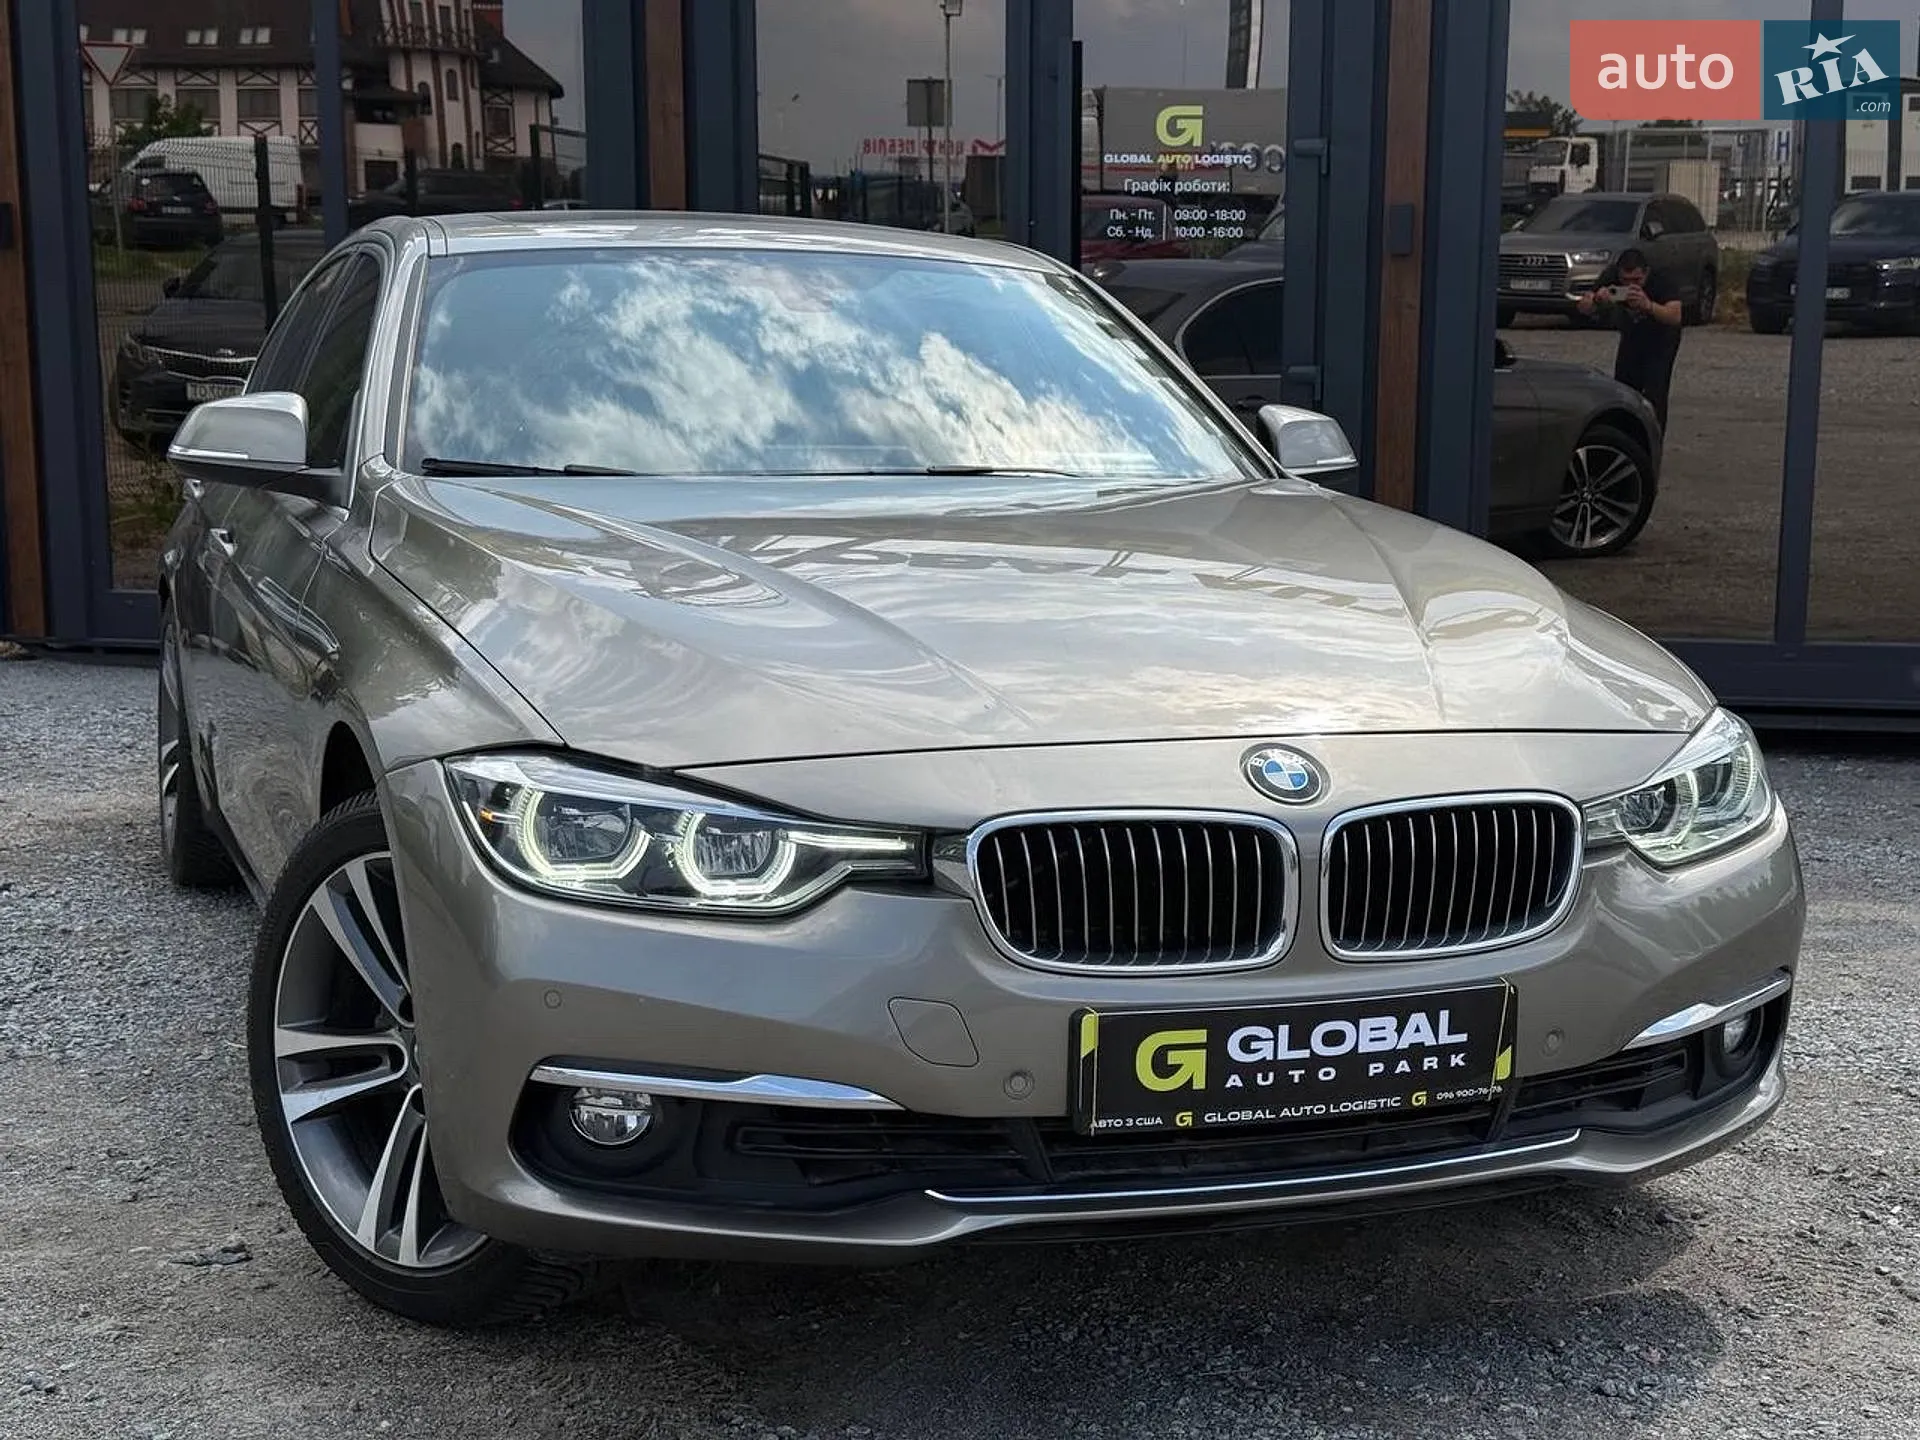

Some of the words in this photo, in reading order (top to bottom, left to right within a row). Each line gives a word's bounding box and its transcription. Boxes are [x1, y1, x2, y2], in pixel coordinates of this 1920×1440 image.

[1104, 153, 1153, 164] GLOBAL
[1157, 153, 1192, 164] AUTO
[1195, 153, 1253, 164] LOGISTIC
[1124, 178, 1171, 194] Графік
[1175, 178, 1231, 194] роботи:
[1174, 209, 1207, 221] 09:00
[1174, 226, 1207, 238] 10:00
[1226, 1009, 1469, 1063] GLOBAL
[1224, 1067, 1337, 1089] AUTO
[1368, 1053, 1467, 1077] PARK
[1204, 1109, 1276, 1123] GLOBAL
[1279, 1104, 1327, 1118] AUTO
[1330, 1096, 1401, 1114] LOGISTIC
[1135, 1116, 1164, 1126] США
